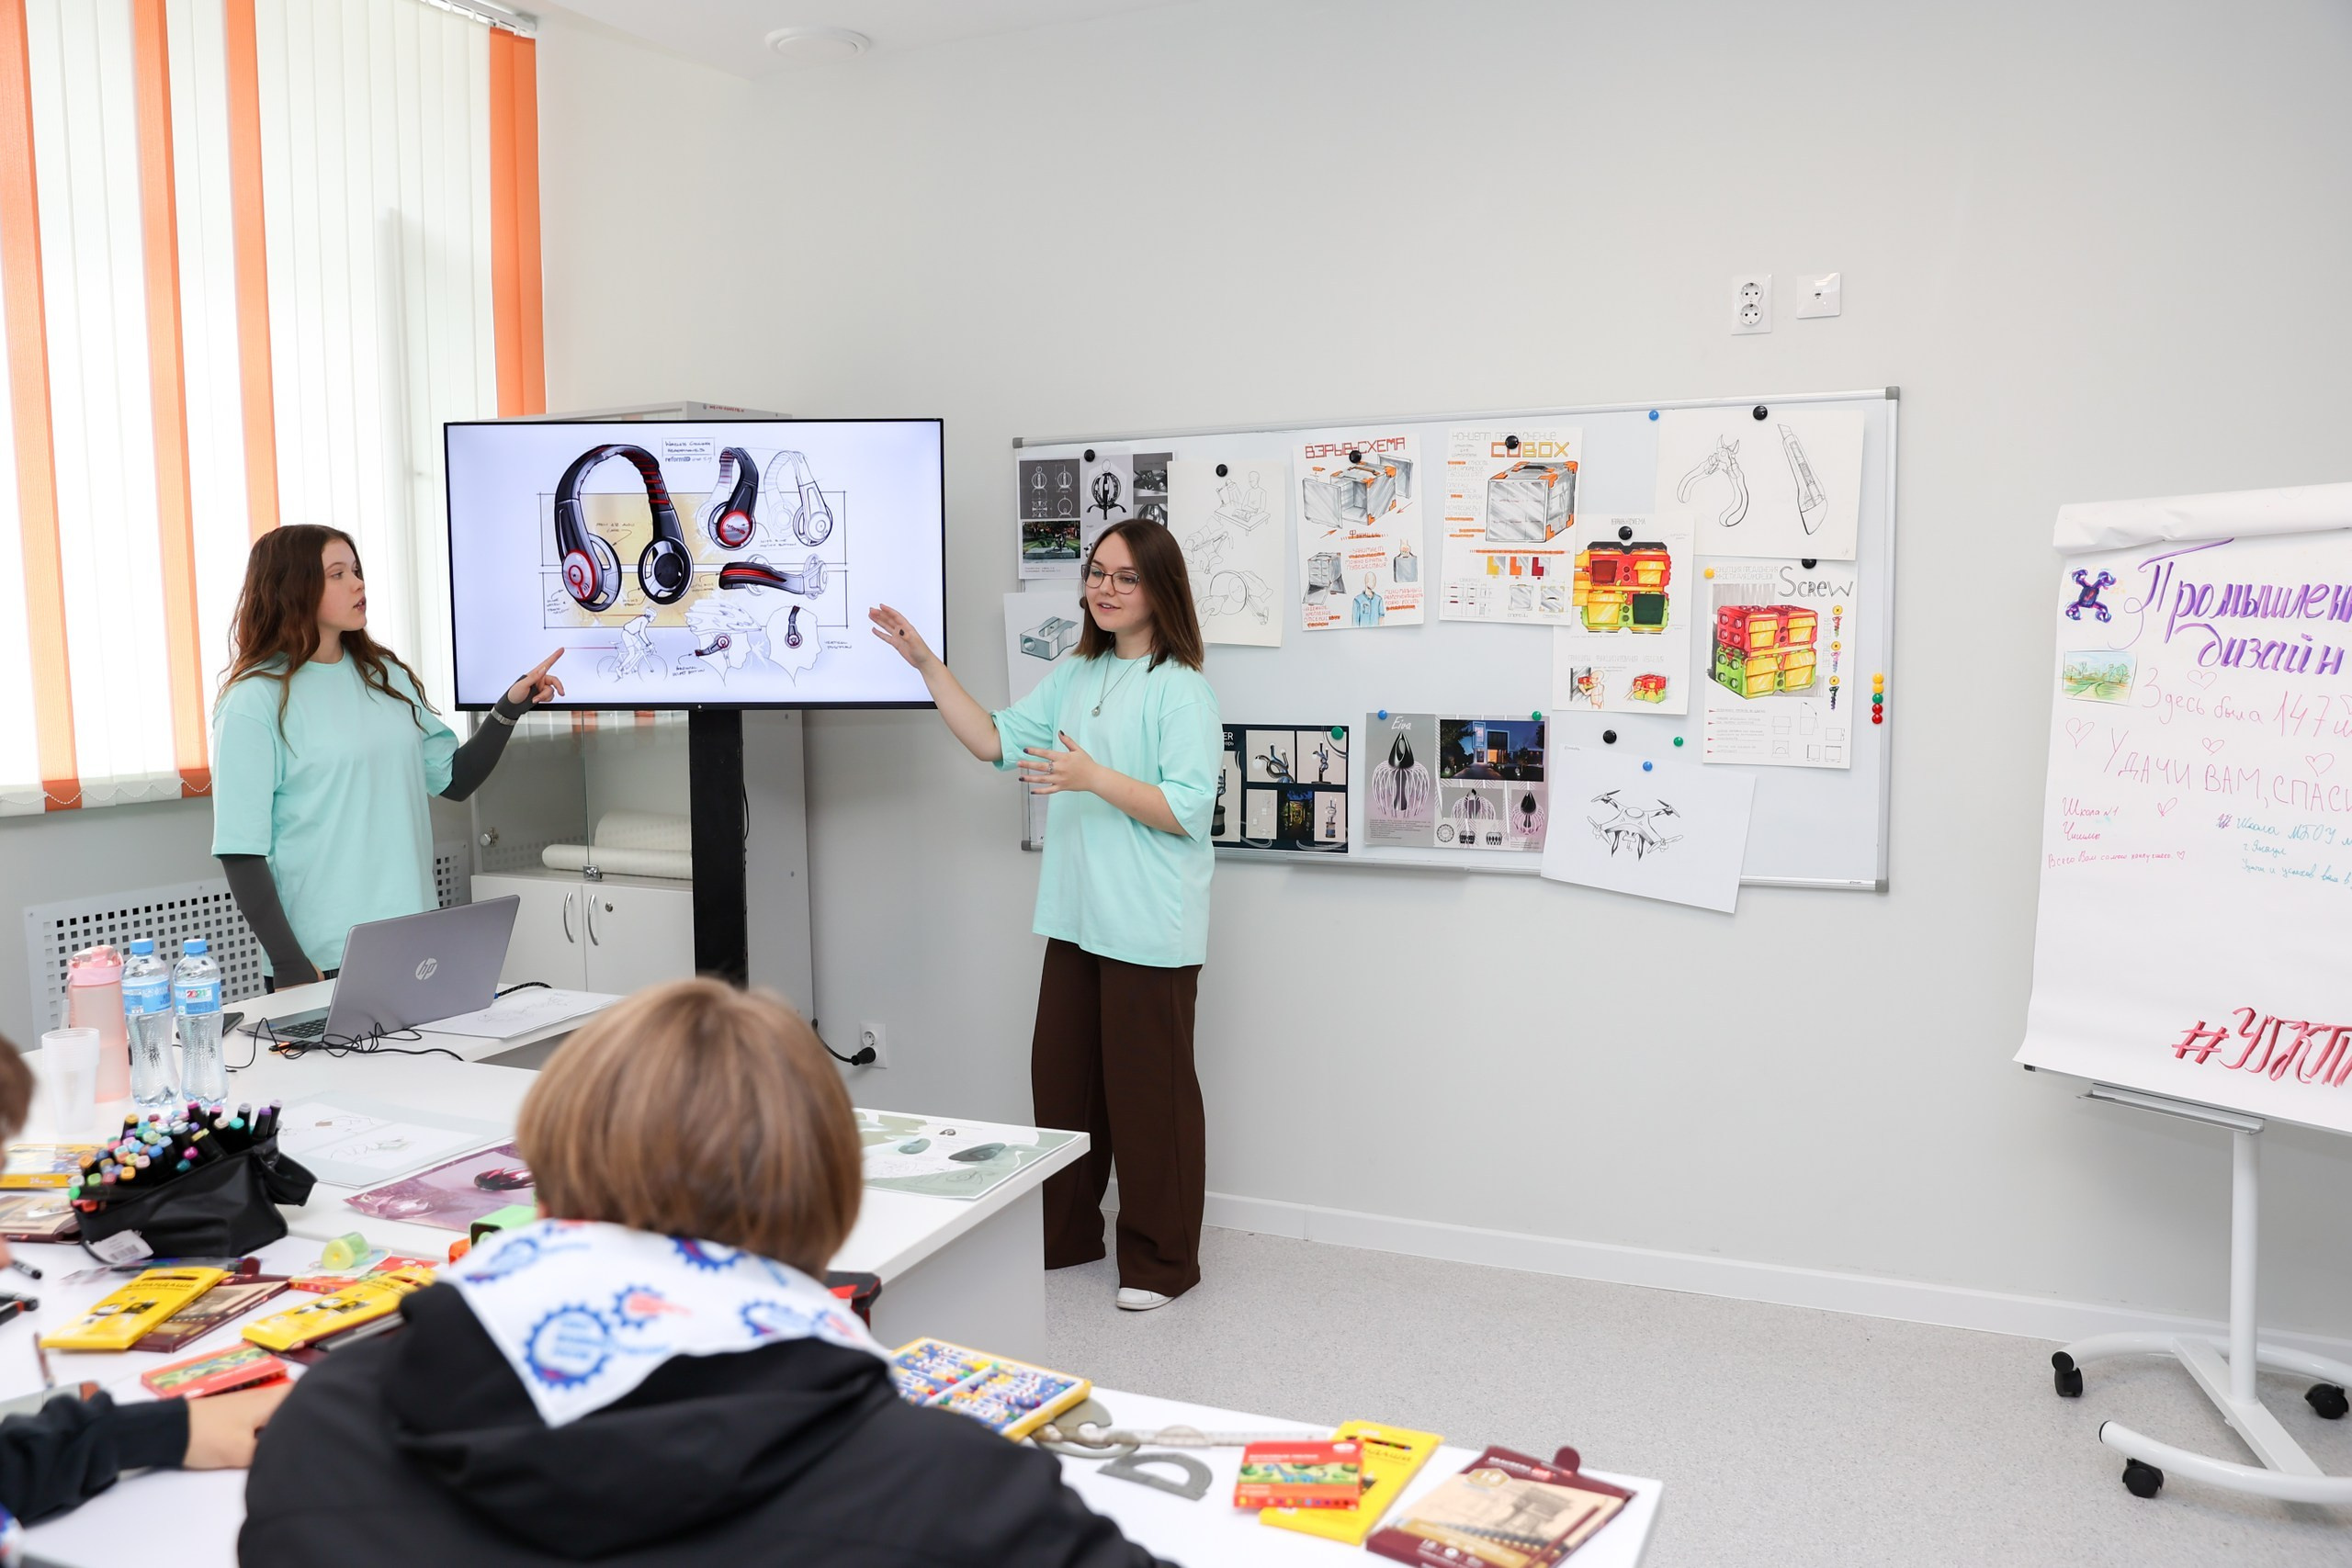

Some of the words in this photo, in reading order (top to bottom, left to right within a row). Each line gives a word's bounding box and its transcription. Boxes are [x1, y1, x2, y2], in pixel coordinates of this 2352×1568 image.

[2175, 623, 2346, 675] дизайн
[2142, 668, 2206, 725] Здесь
[2273, 690, 2331, 738] 147
[2104, 728, 2191, 790] УДАЧИ
[2062, 796, 2100, 817] Школа
[415, 957, 438, 981] hp
